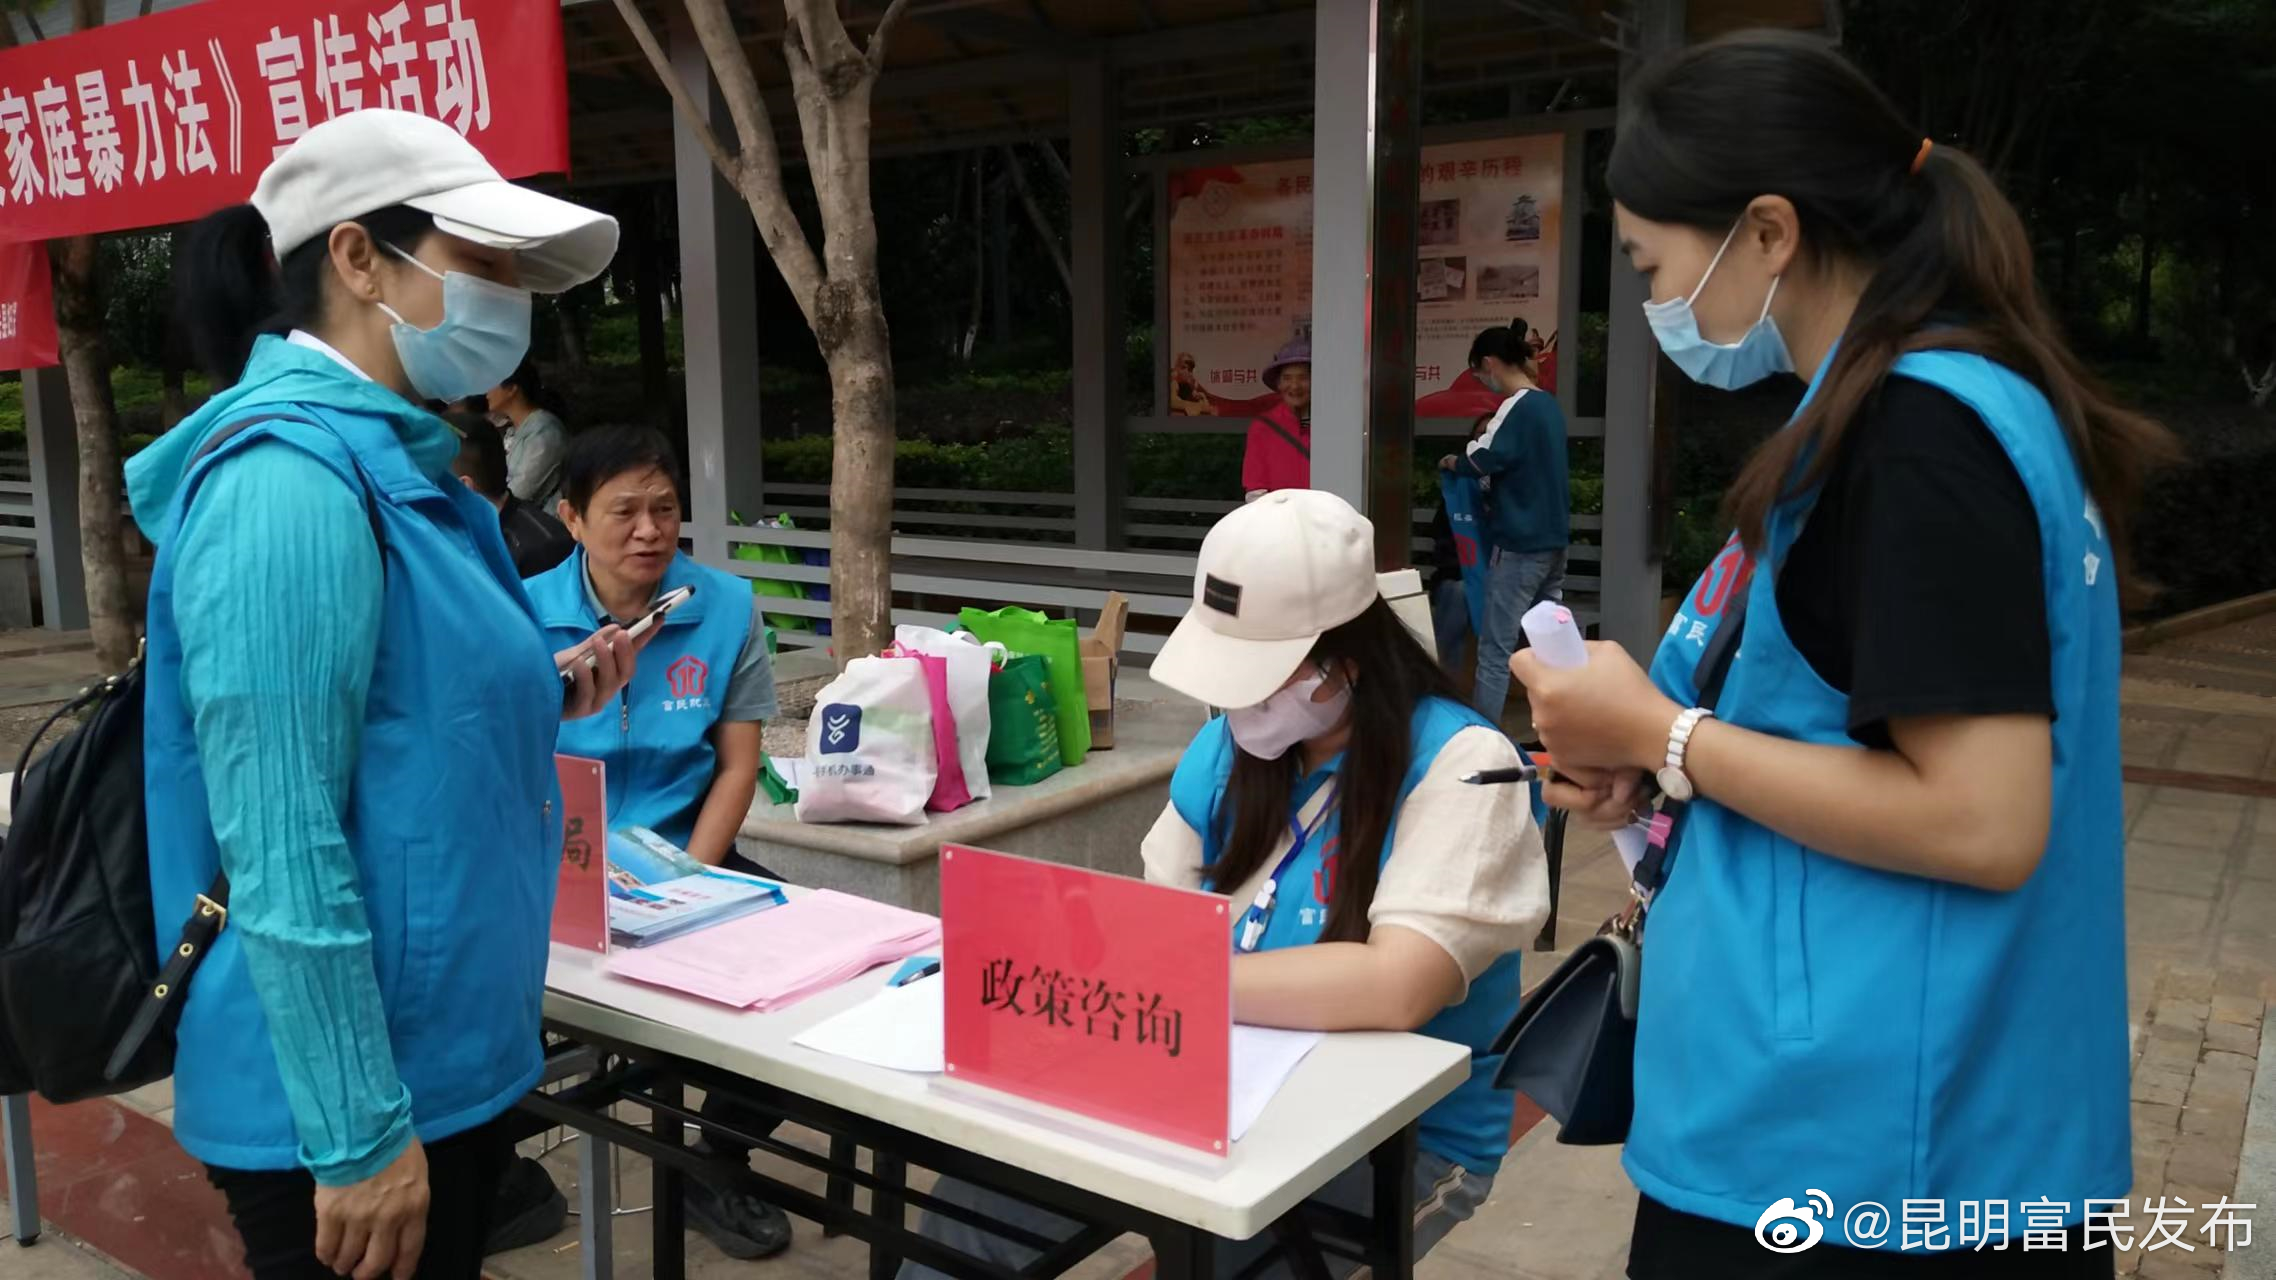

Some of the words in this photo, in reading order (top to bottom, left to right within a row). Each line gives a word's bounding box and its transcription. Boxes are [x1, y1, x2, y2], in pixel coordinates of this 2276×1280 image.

[0, 0, 491, 207] 家庭暴力法》宣传活动
[980, 958, 1182, 1057] 政策咨询
